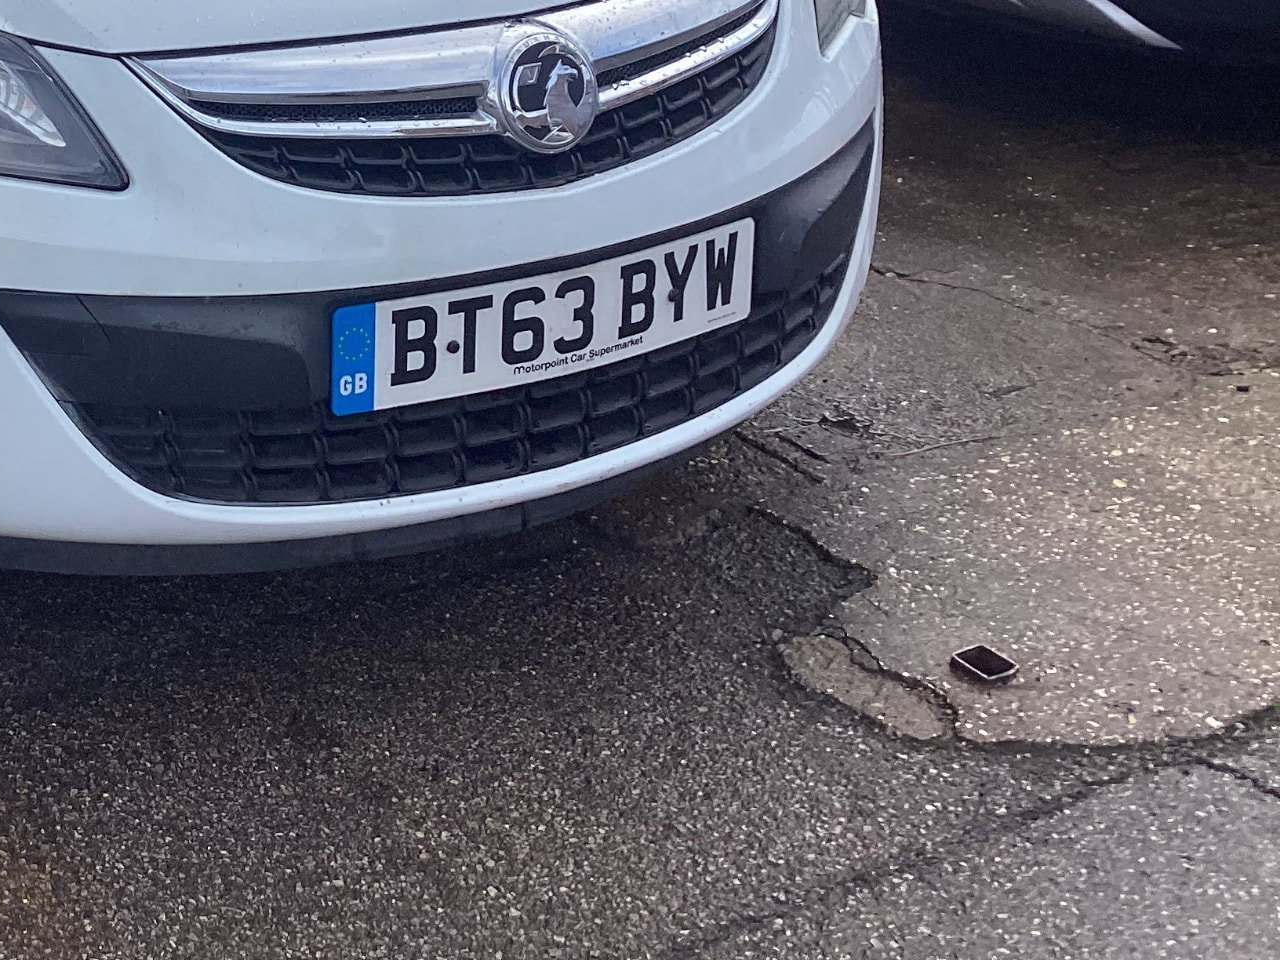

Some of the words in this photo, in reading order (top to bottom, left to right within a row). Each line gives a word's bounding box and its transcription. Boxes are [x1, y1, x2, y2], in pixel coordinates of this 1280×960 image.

[390, 275, 596, 387] BT63
[617, 230, 738, 340] BYW
[513, 357, 569, 375] Motorpoint
[570, 352, 587, 363] Car
[589, 335, 644, 359] Supermarket
[339, 372, 368, 396] GB
